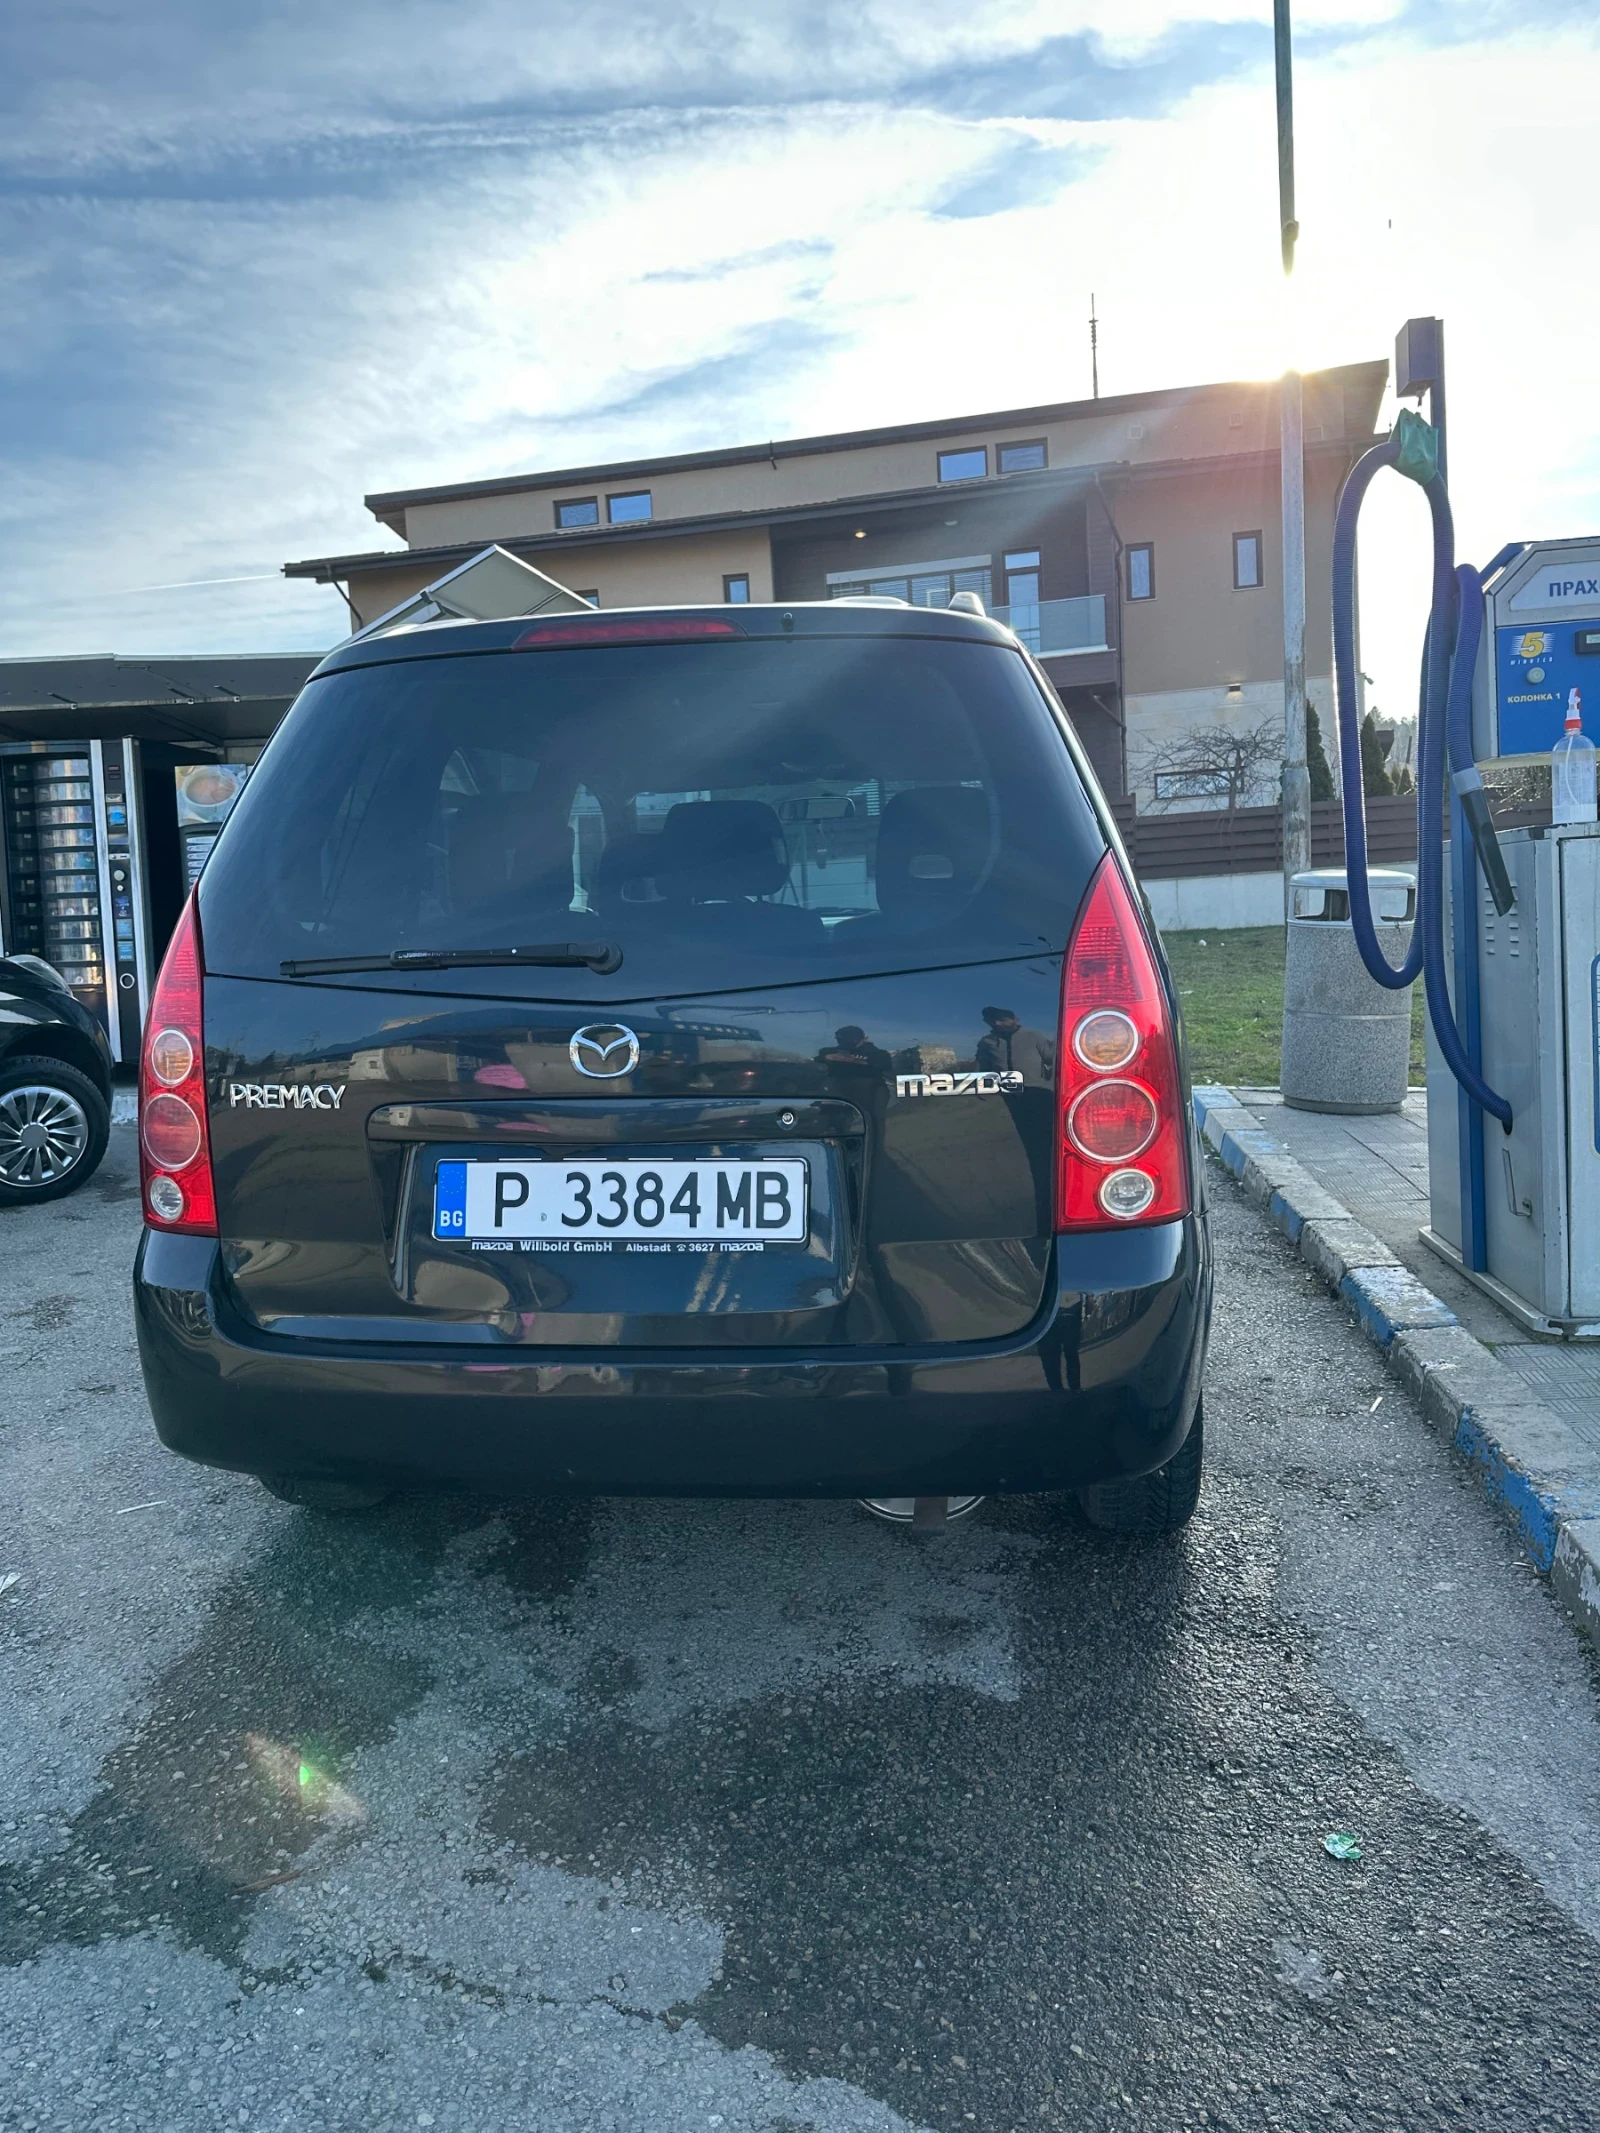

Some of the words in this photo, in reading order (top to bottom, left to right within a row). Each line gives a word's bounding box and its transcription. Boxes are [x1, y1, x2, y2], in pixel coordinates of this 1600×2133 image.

[1519, 631, 1545, 659] 5
[1507, 693, 1553, 704] КОЛОНКА
[1555, 692, 1561, 700] 1
[229, 1083, 346, 1109] PREMACY
[494, 1171, 530, 1228] P
[561, 1171, 701, 1228] 3384
[716, 1171, 792, 1229] MB
[440, 1210, 463, 1228] BG
[520, 1241, 570, 1252] Willbold
[573, 1241, 613, 1252] GmbH
[625, 1242, 672, 1252] Albstadt
[688, 1242, 715, 1252] 3627
